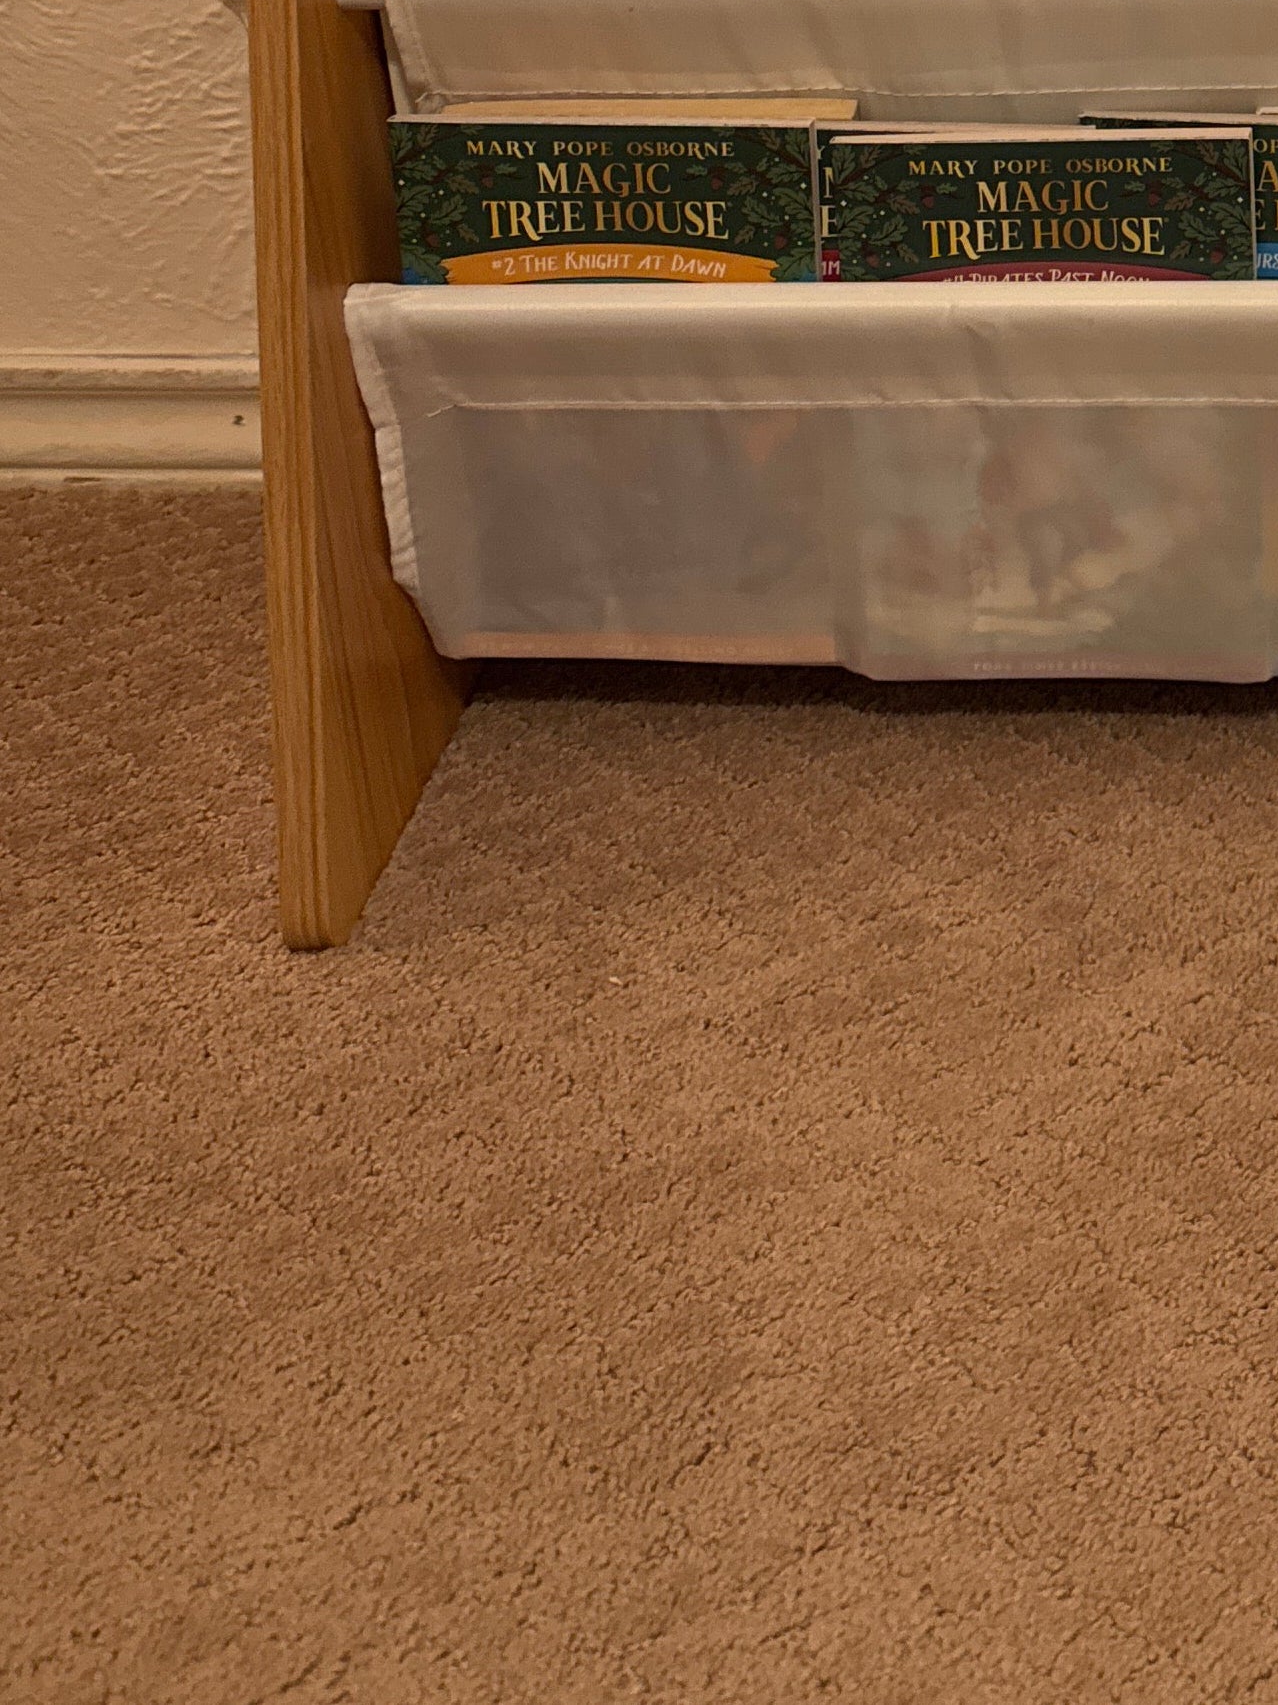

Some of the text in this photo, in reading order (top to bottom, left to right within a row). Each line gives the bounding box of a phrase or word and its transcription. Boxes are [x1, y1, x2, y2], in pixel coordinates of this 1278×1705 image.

[467, 140, 736, 160] MARY POPE OSBORNE
[908, 157, 1173, 179] MARY POPE OSBORNE
[537, 162, 671, 198] MAGIC
[976, 179, 1109, 216] MAGIC
[482, 200, 730, 241] TREE HOUSE
[922, 216, 1167, 260] TREE HOUSE
[491, 251, 727, 279] #2 THE KNIGHT AT DAWN
